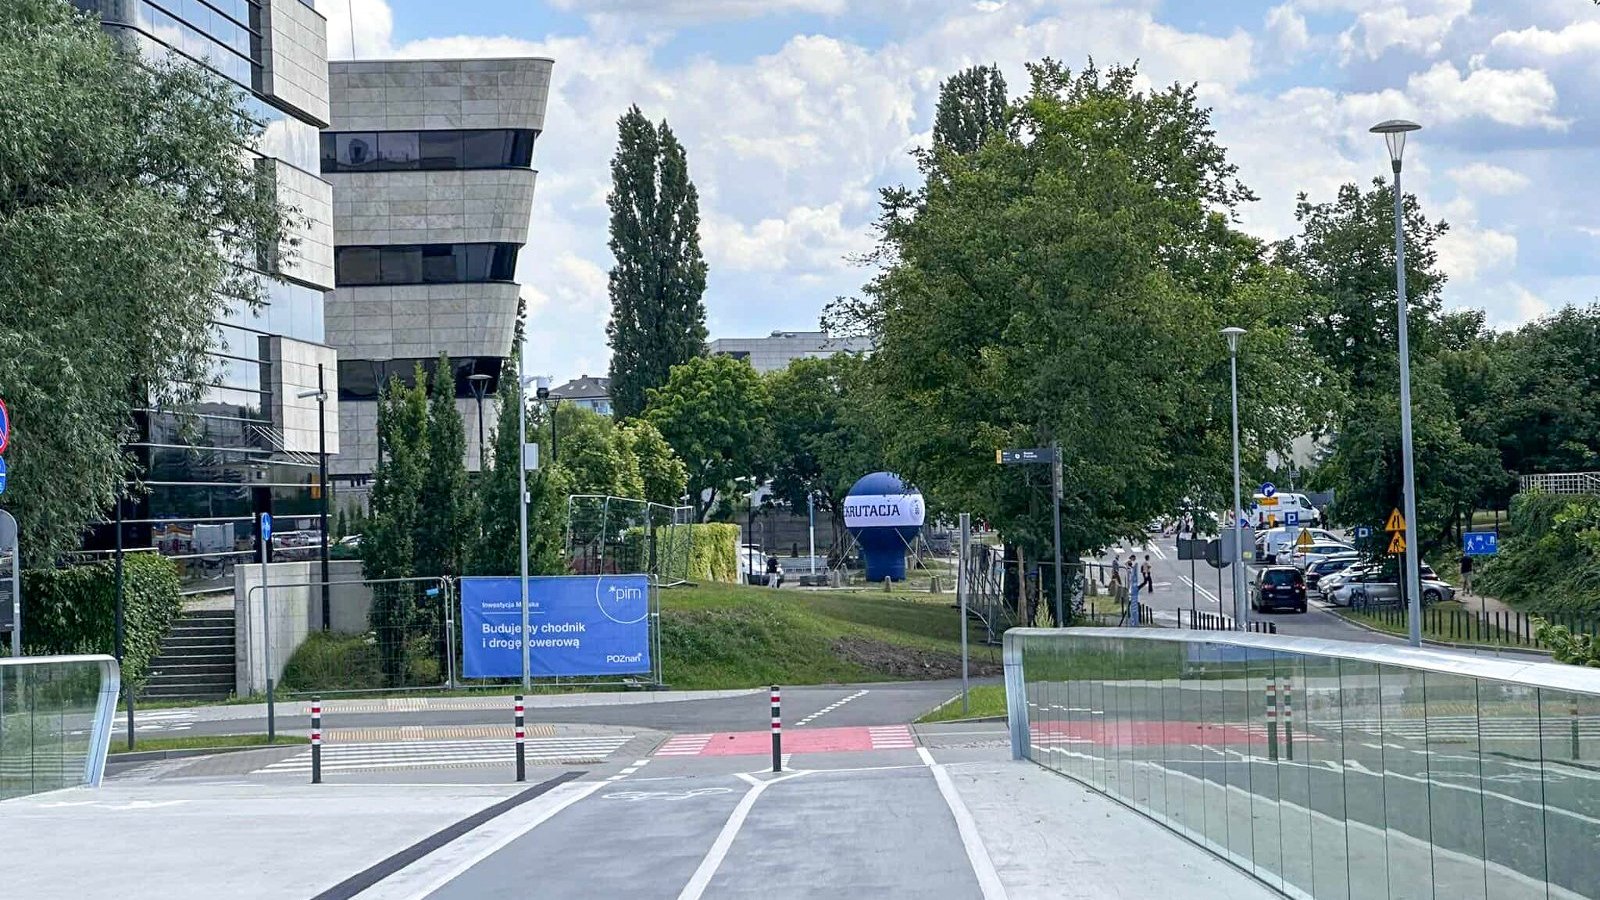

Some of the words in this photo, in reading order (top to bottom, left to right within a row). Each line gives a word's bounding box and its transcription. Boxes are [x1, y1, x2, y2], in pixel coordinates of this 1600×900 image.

[1288, 514, 1296, 524] P
[541, 622, 586, 633] chodnik
[482, 638, 486, 648] i
[489, 637, 522, 650] drogę
[527, 637, 580, 649] owerową
